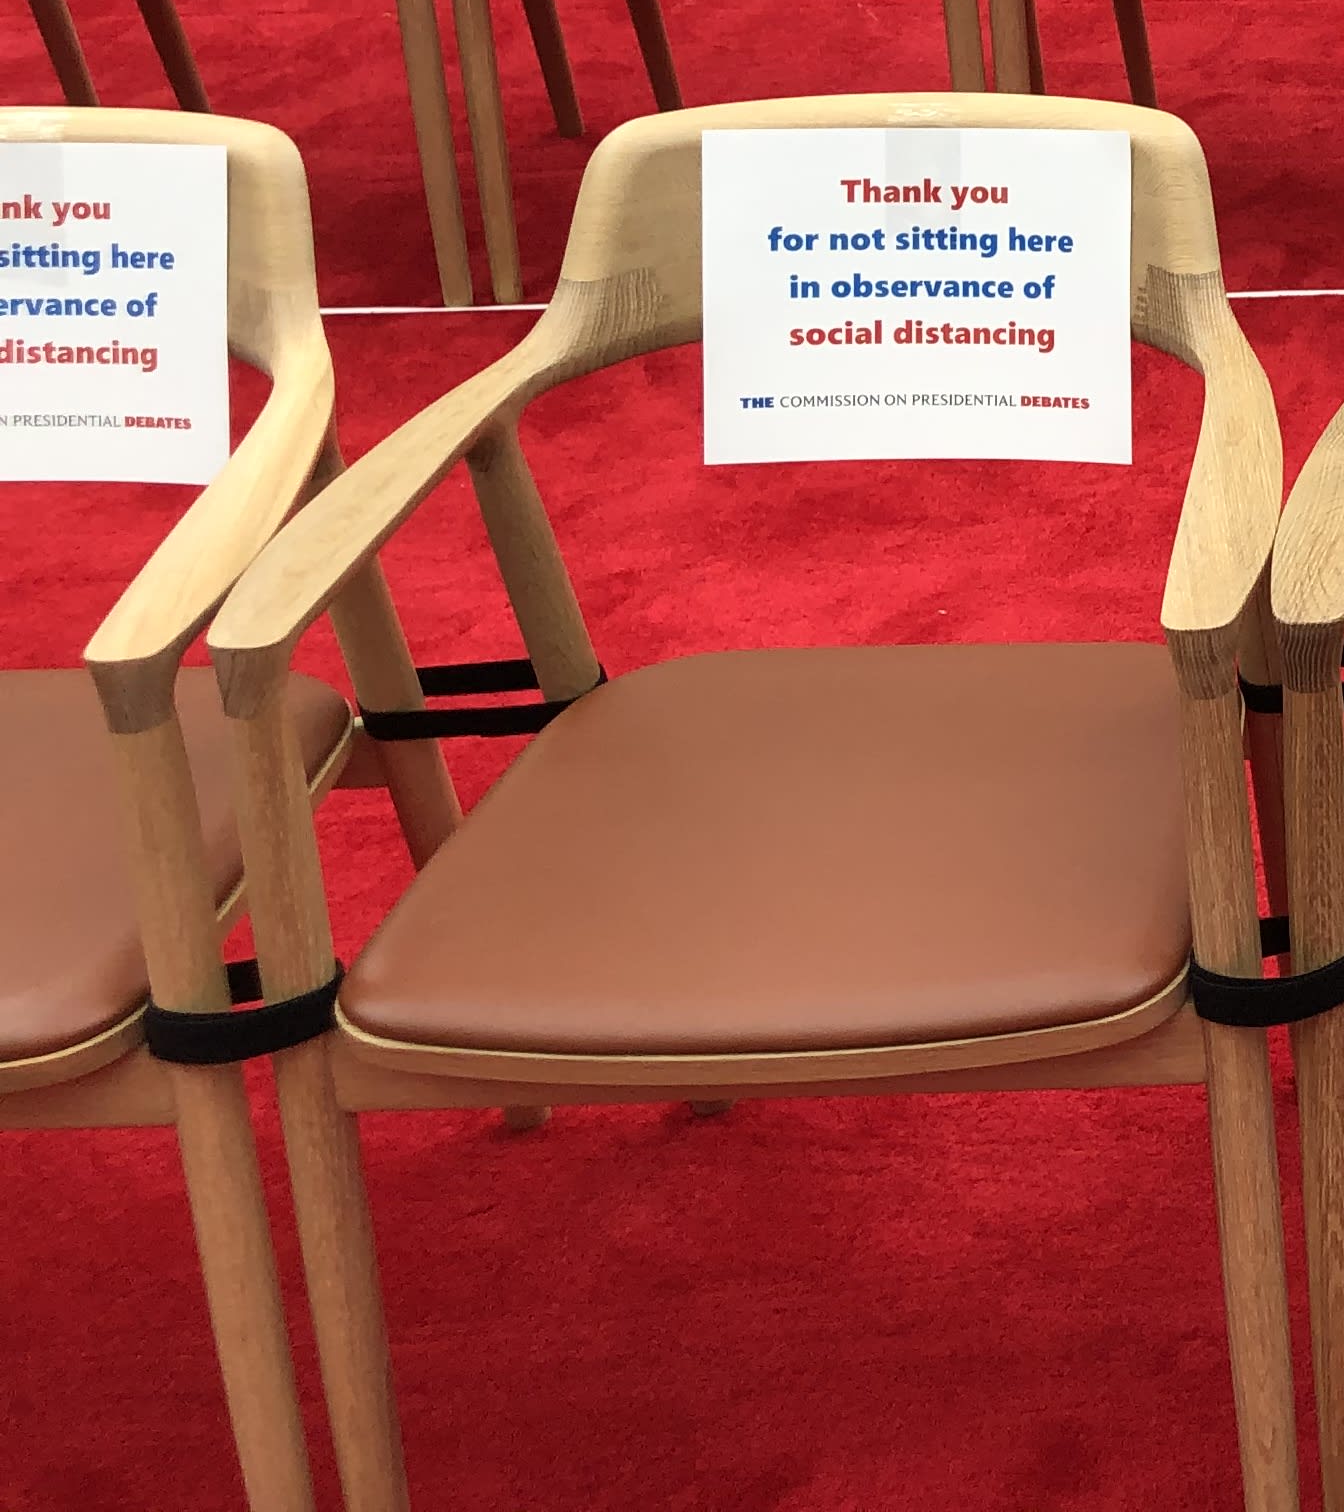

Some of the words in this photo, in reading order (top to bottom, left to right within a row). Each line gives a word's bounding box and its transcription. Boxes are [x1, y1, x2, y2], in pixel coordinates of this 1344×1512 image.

[840, 178, 942, 203] Thank
[950, 186, 1008, 210] you
[52, 202, 110, 226] you
[768, 226, 819, 252] for
[830, 228, 885, 250] not
[896, 226, 998, 258] sitting
[1009, 226, 1073, 253] here
[0, 243, 100, 276] sitting
[112, 243, 174, 270] here
[790, 274, 820, 298] in
[831, 273, 1014, 298] observance
[1024, 274, 1056, 299] of
[0, 298, 117, 316] ervance
[126, 292, 158, 317] of
[790, 320, 882, 346] social
[893, 320, 1054, 354] distancing
[0, 338, 158, 372] distancing
[740, 397, 774, 408] THE
[780, 394, 880, 408] COMMISSION
[884, 394, 906, 406] ON
[912, 394, 1016, 407] PRESIDENTIAL
[1021, 396, 1090, 409] DEBATES
[14, 415, 121, 427] PRESIDENTIAL
[124, 416, 191, 430] DEBATES
